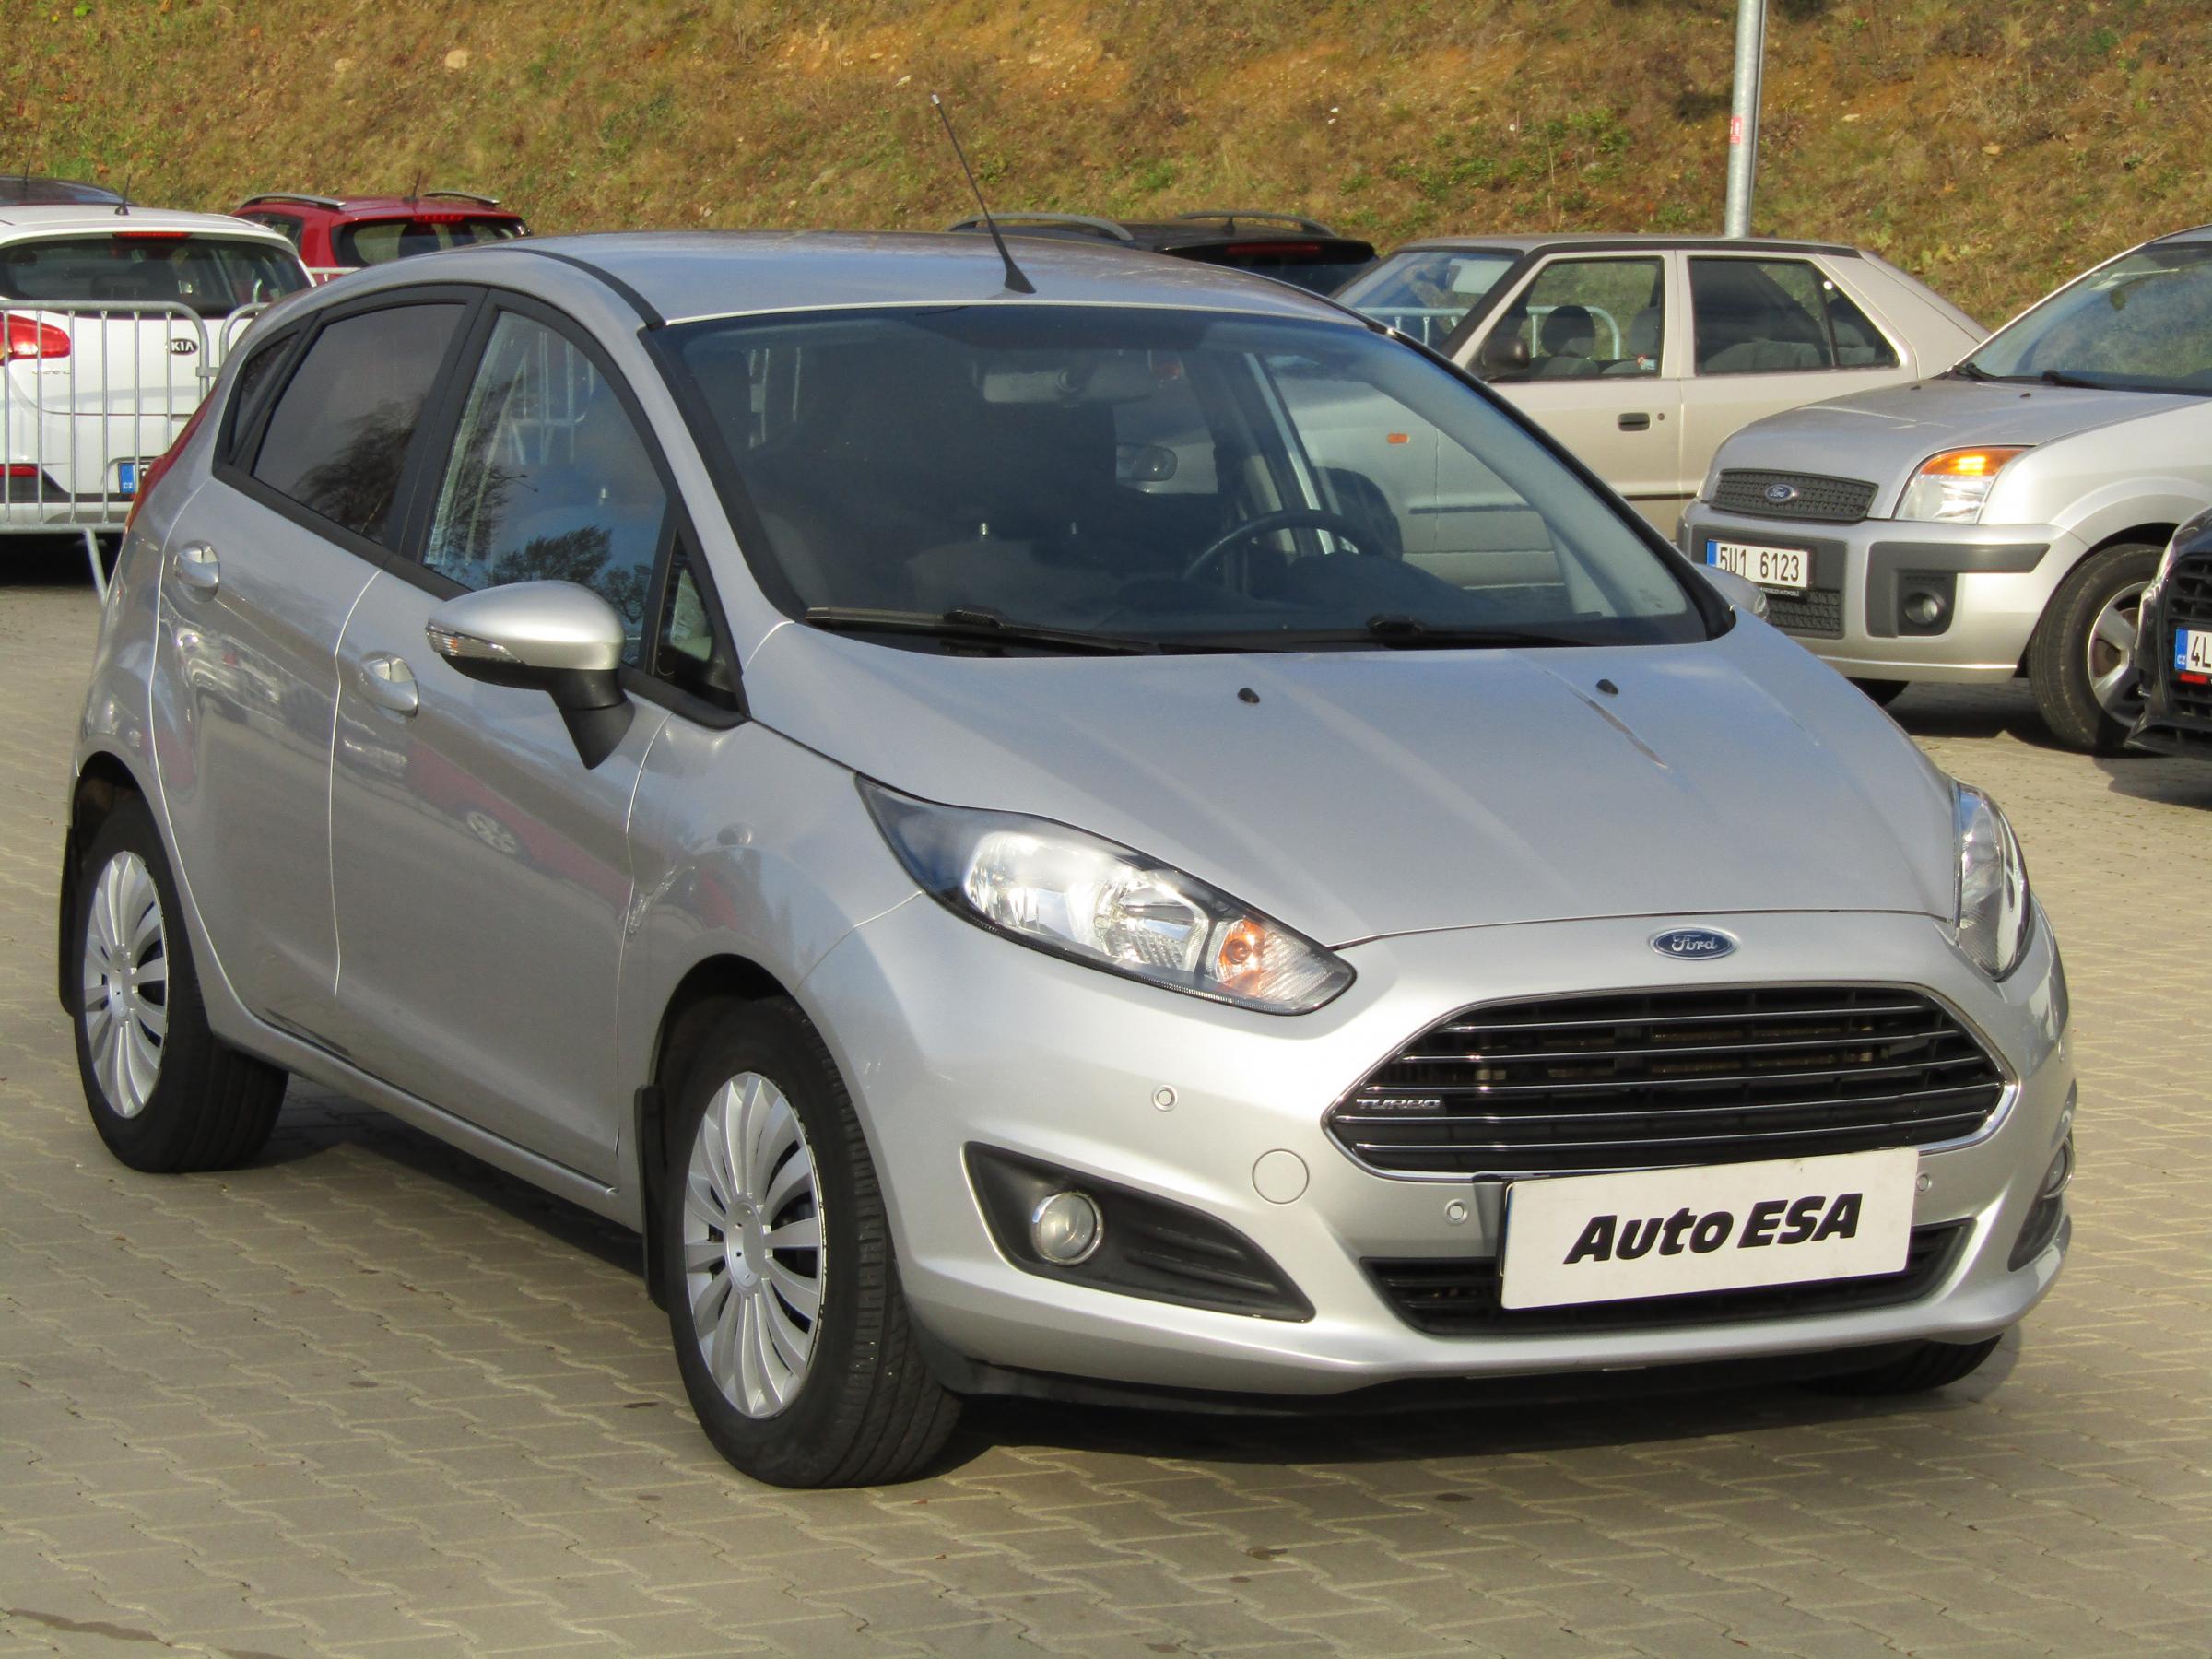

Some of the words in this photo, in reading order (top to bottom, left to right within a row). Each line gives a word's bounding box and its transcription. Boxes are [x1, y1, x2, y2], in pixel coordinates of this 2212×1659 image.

[171, 340, 194, 352] KIA
[1720, 547, 1747, 577] 5U1
[1759, 551, 1800, 582] 6123
[2176, 654, 2186, 665] CZ
[2190, 636, 2212, 668] 4L
[1671, 935, 1718, 952] Ford
[1356, 1098, 1441, 1110] TURBO
[1562, 1207, 1735, 1265] Auto
[1736, 1193, 1863, 1249] ESA
